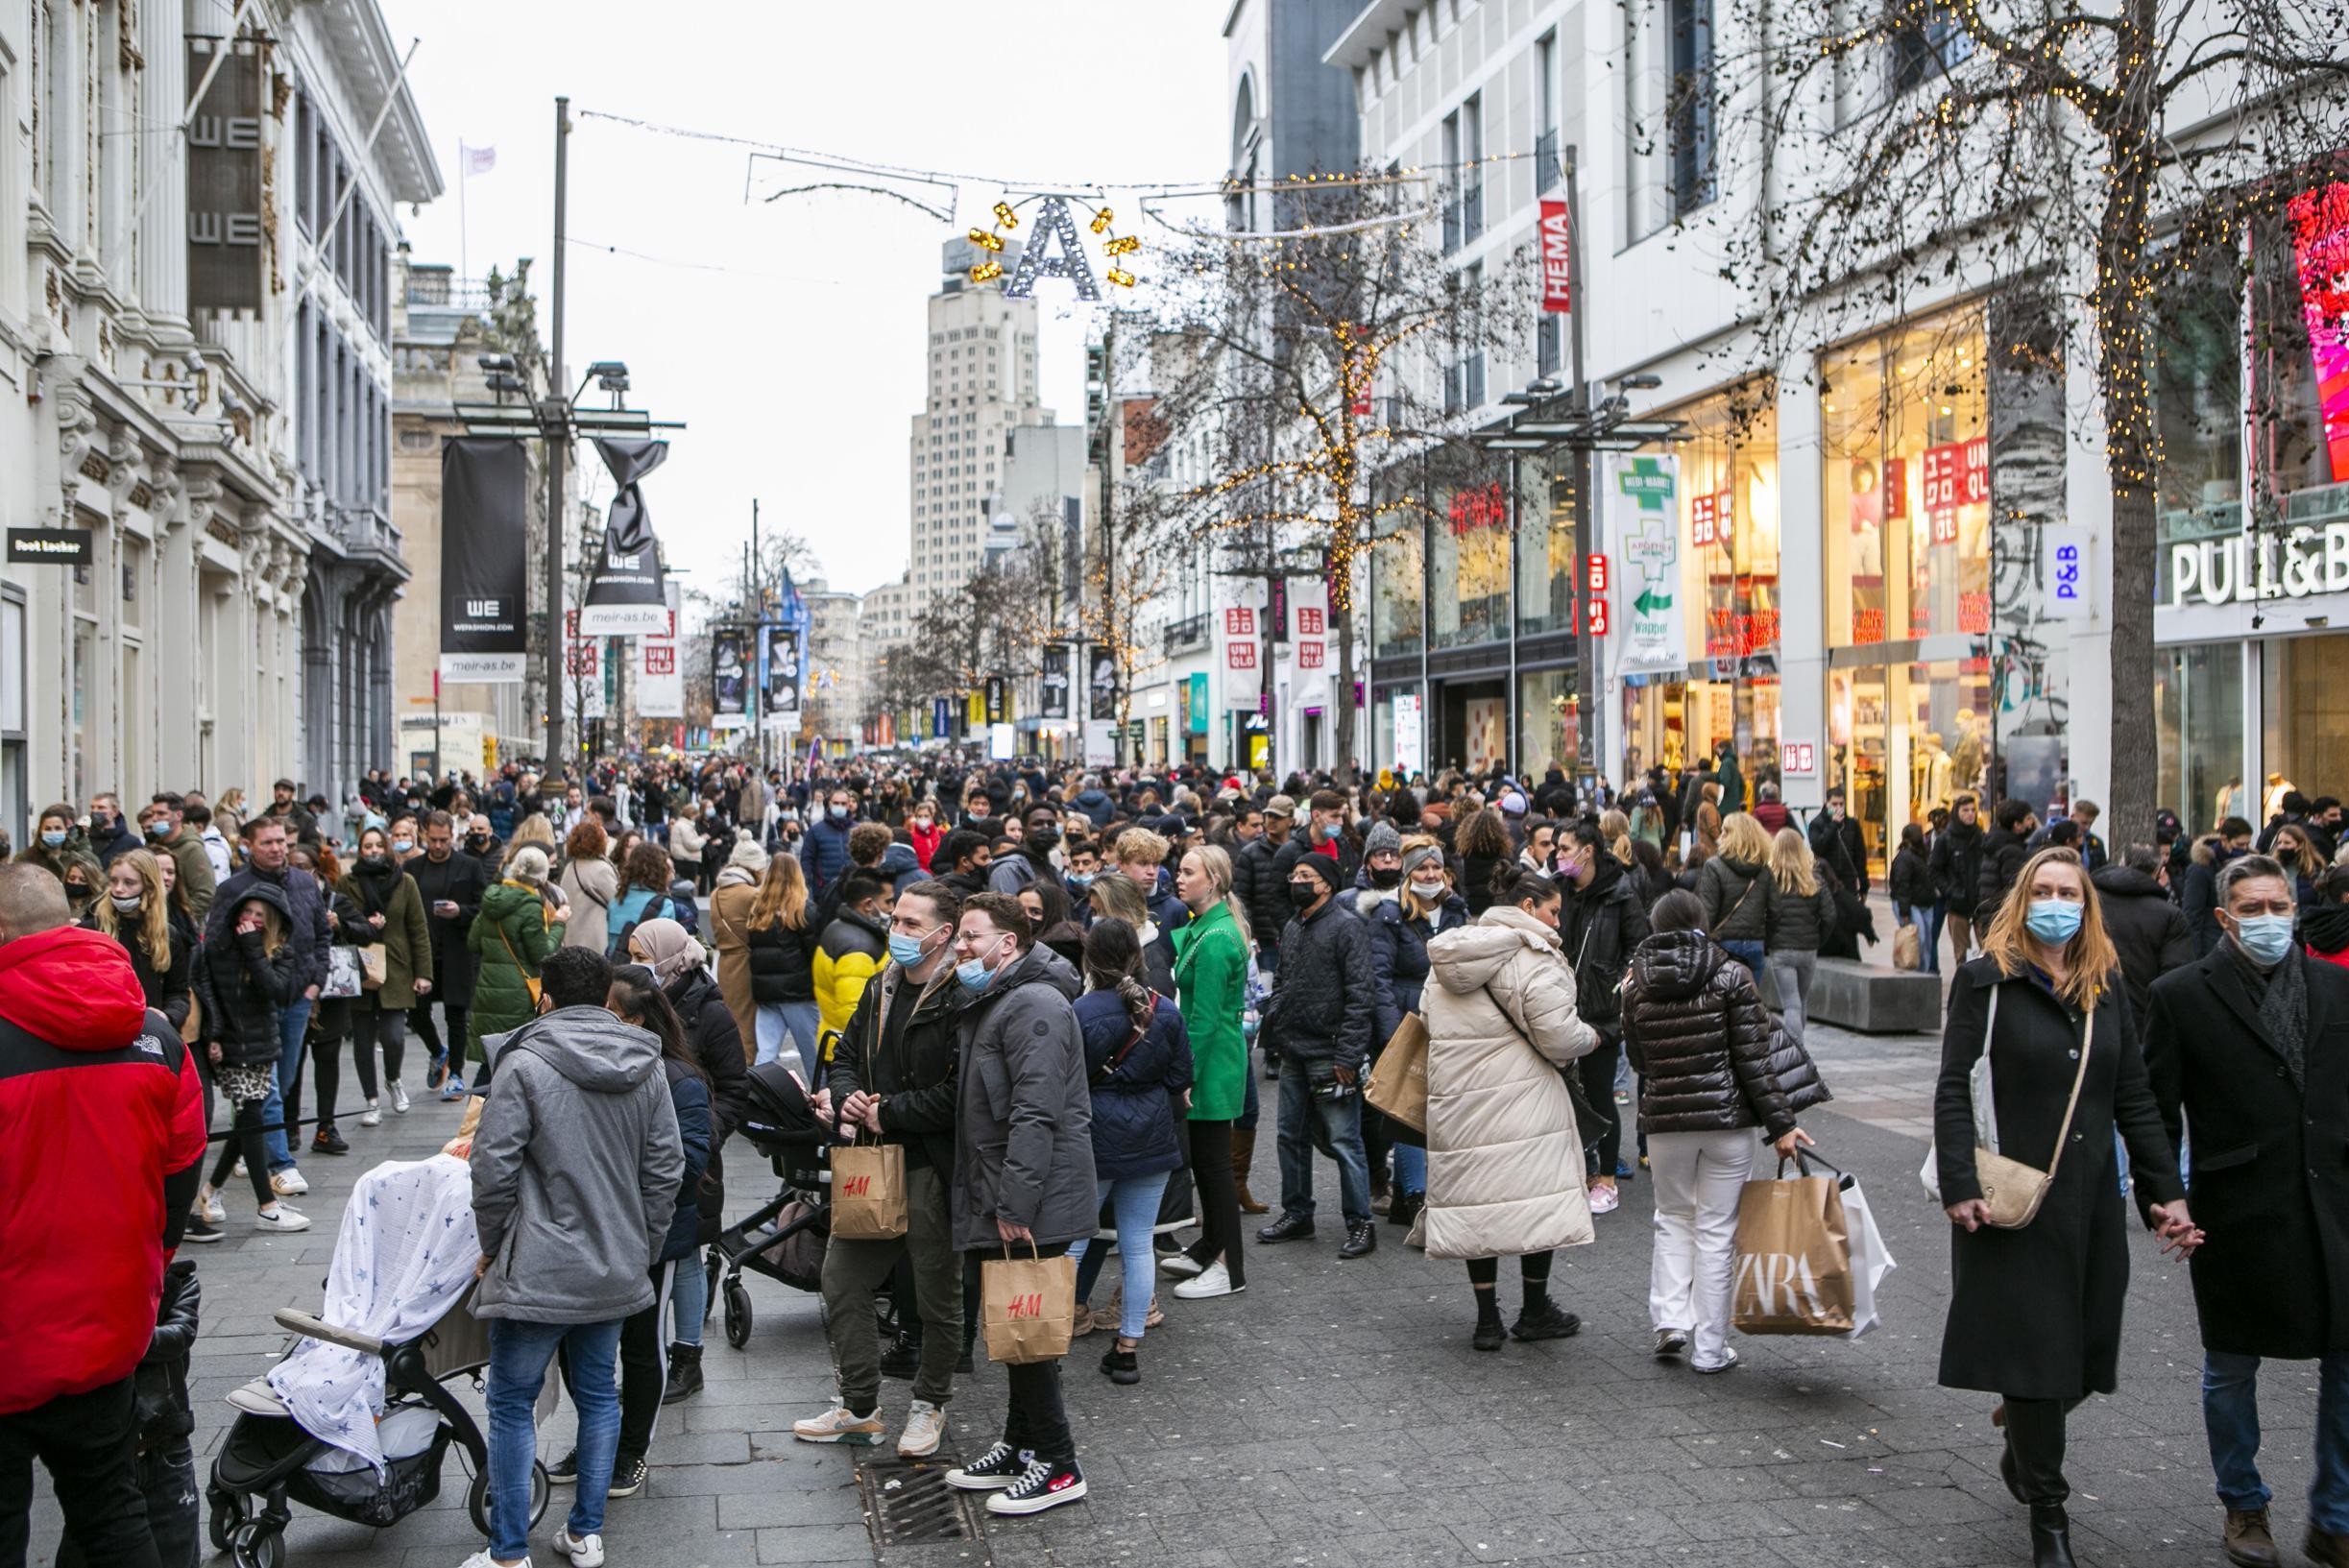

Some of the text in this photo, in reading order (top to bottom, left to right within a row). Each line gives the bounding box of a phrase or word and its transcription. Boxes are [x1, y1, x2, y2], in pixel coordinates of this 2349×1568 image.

[190, 116, 259, 148] WE
[190, 212, 259, 246] WE
[1544, 213, 1569, 299] HEMA
[1967, 442, 1988, 470] UN
[1968, 470, 1989, 500] QL
[608, 554, 641, 570] WE
[2057, 544, 2078, 599] P&B
[467, 600, 499, 617] WE
[592, 612, 658, 623] meir-as.be
[453, 623, 515, 633] WEFASHION.COM
[648, 648, 670, 660] UNI
[1231, 644, 1252, 656] UNI
[1301, 643, 1321, 655] UNI
[452, 661, 516, 671] meir-as.be
[647, 661, 672, 672] QLO
[1231, 656, 1255, 667] QLO
[1302, 655, 1322, 666] QLO
[842, 1175, 871, 1197] H&M
[1732, 1251, 1827, 1319] ZARA
[1007, 1292, 1043, 1319] H&M
